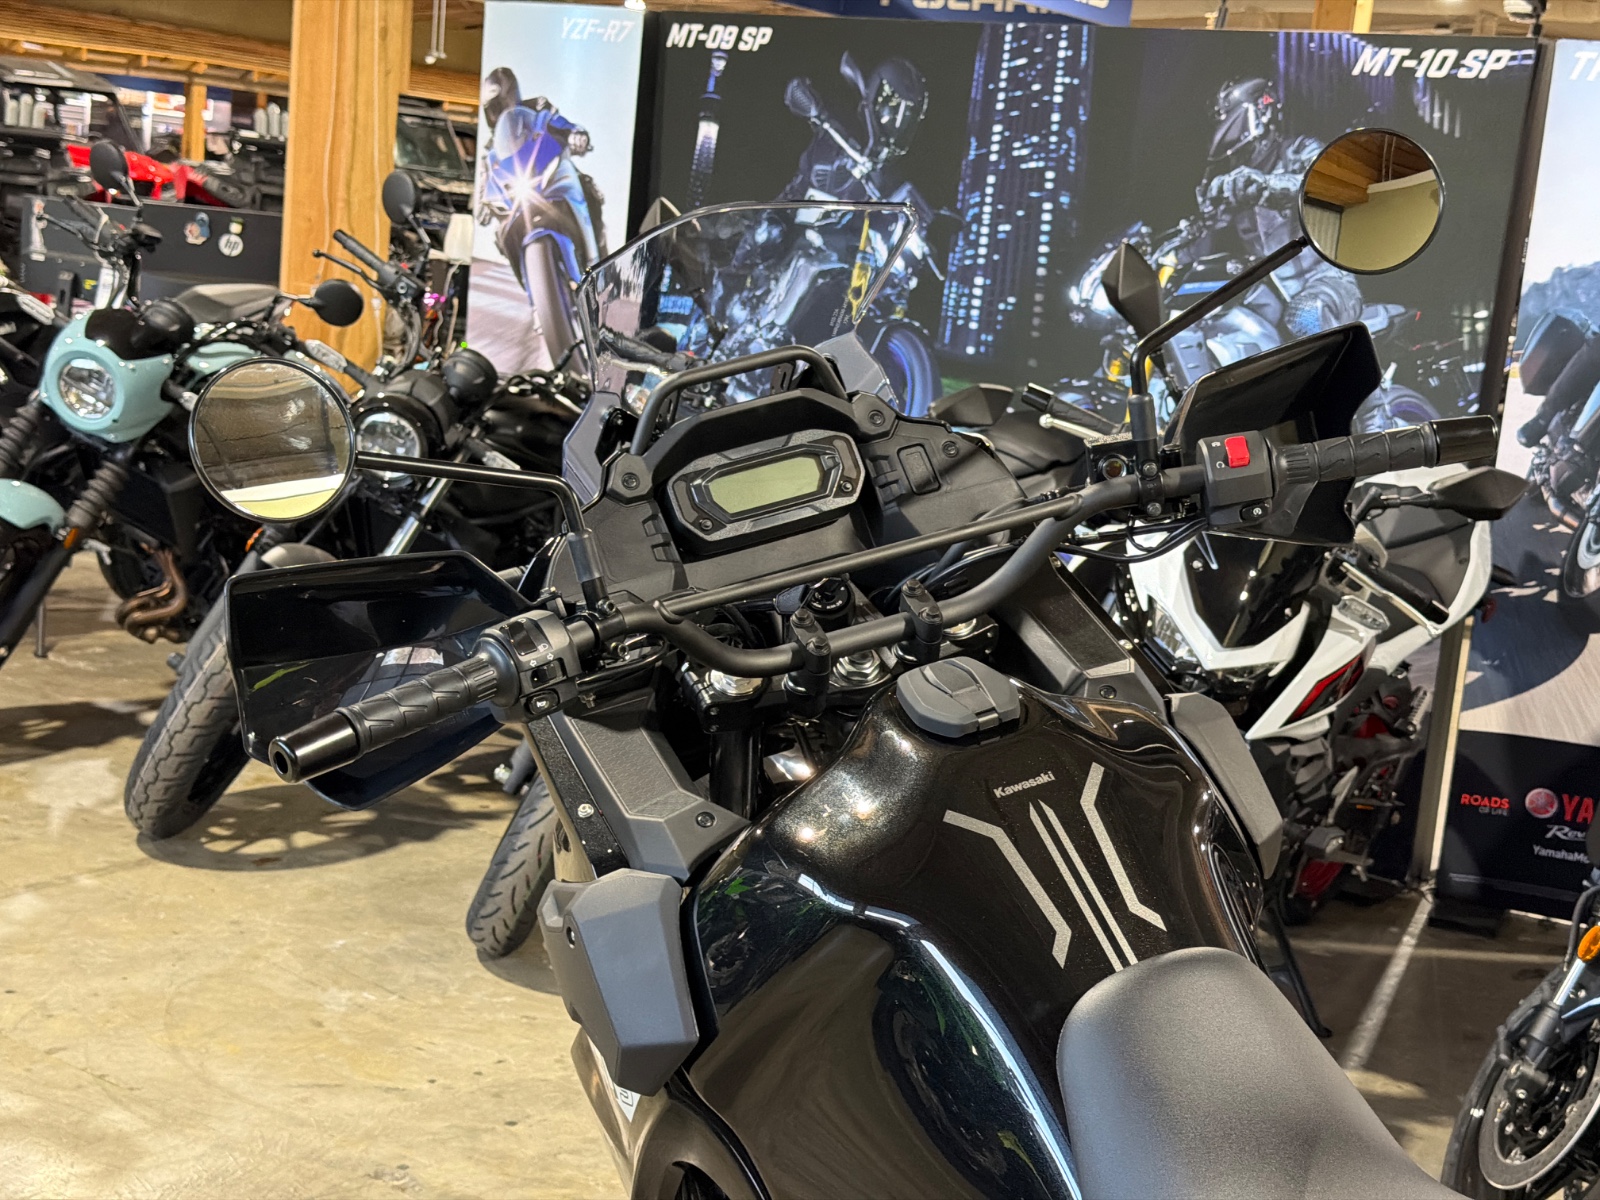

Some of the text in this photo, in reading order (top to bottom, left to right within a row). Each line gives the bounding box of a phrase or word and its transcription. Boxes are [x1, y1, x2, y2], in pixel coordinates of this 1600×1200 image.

[561, 17, 635, 42] YZF-R7
[666, 23, 773, 51] MT-09 SP
[1352, 47, 1512, 79] MT-10 SP
[993, 771, 1056, 798] Kawasaki
[1460, 794, 1510, 809] ROADS
